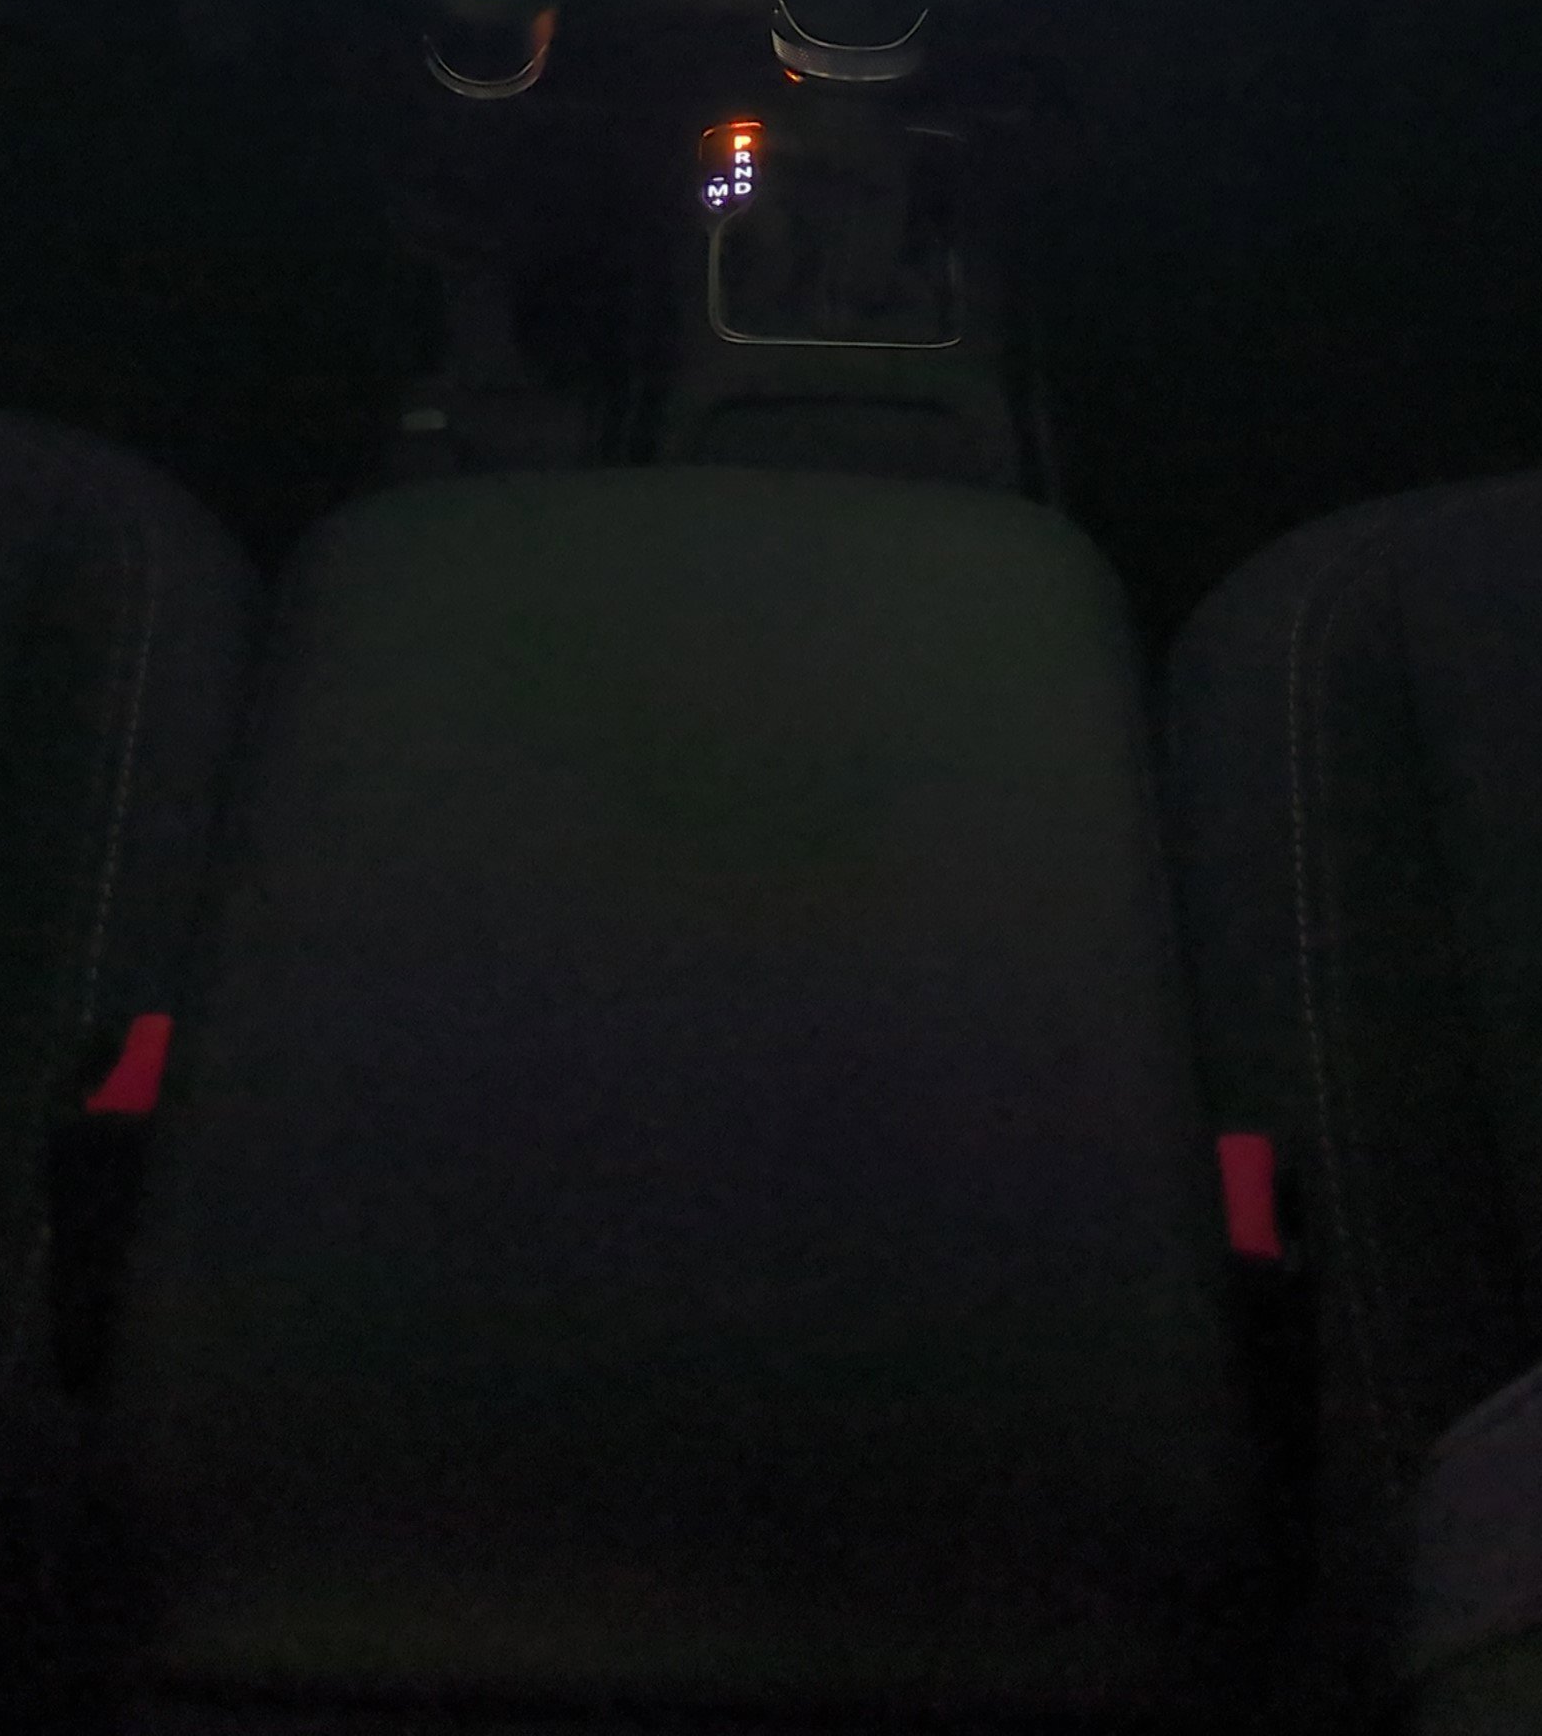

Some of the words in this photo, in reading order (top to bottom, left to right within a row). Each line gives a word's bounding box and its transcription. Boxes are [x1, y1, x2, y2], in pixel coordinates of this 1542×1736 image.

[733, 134, 752, 151] P
[734, 150, 752, 165] R
[734, 165, 753, 180] N
[707, 183, 729, 198] M
[734, 181, 752, 196] D
